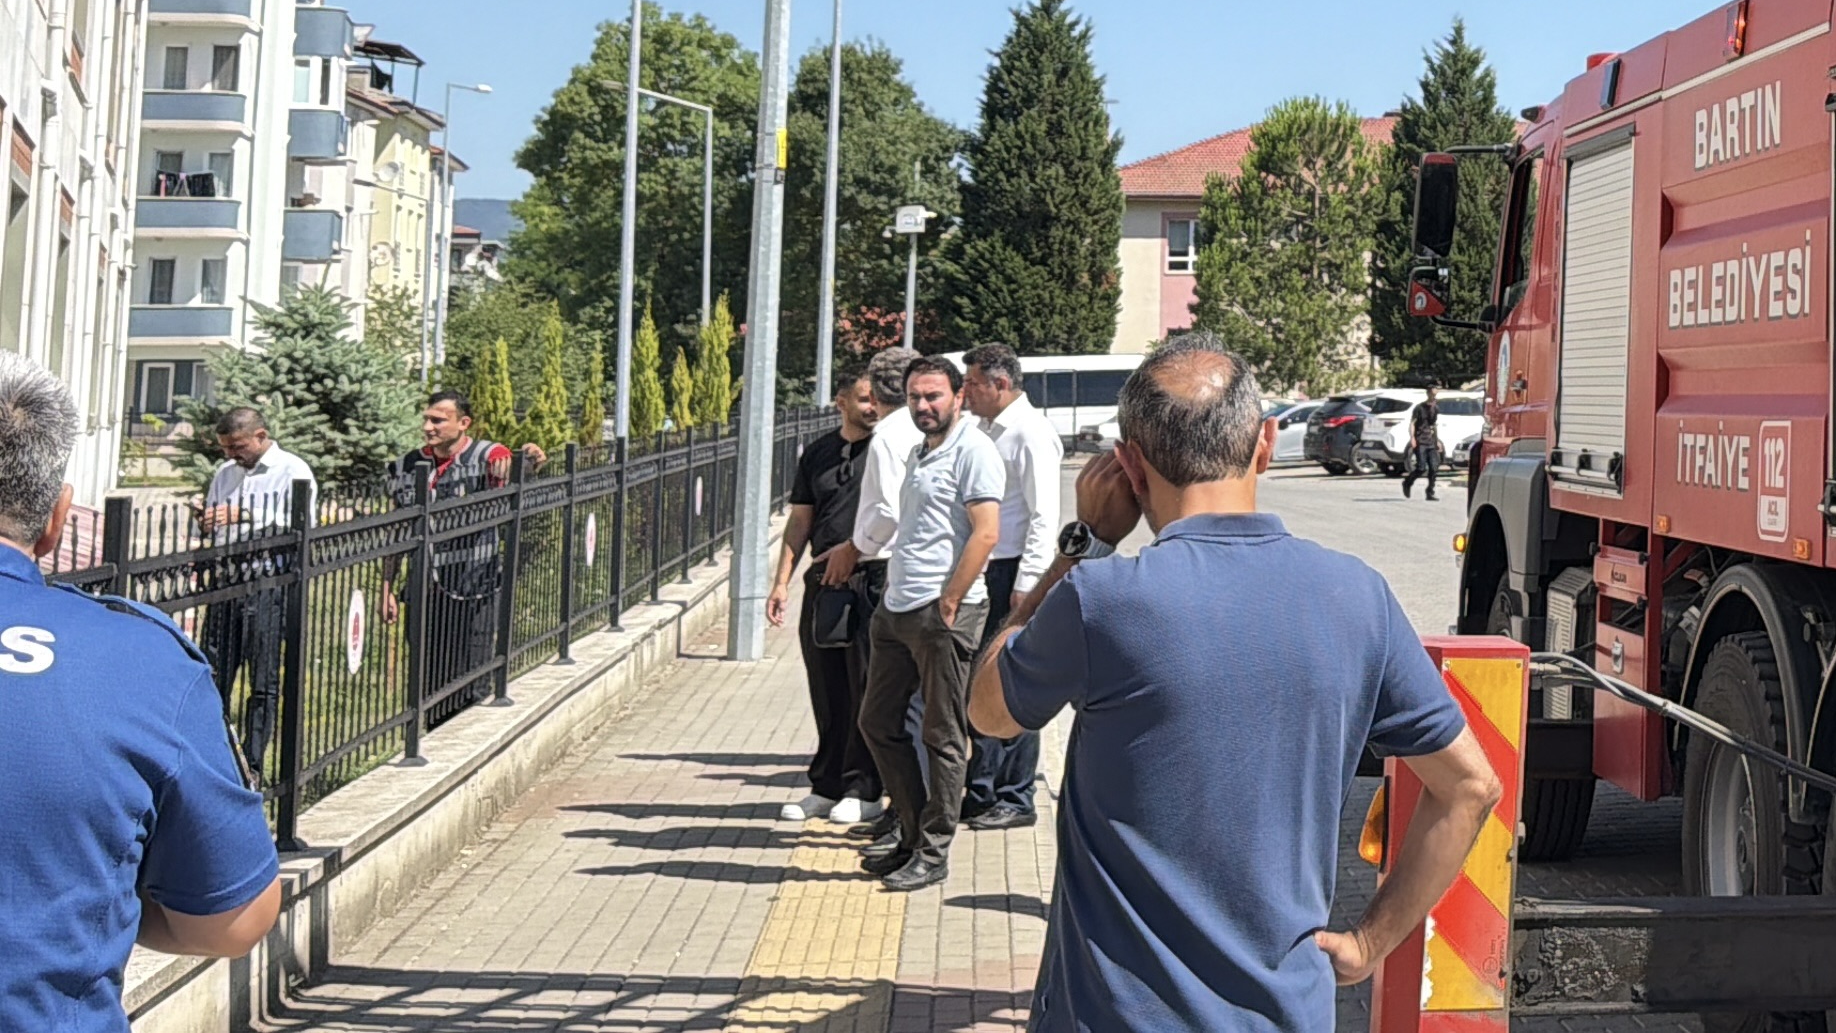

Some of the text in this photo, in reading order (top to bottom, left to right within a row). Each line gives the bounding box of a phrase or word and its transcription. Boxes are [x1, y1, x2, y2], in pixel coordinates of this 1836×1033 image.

[1694, 80, 1782, 170] BARTIN
[1668, 228, 1811, 328] BELEDİYESİ
[1677, 419, 1750, 490] İTFAİYE
[1764, 437, 1785, 488] 112
